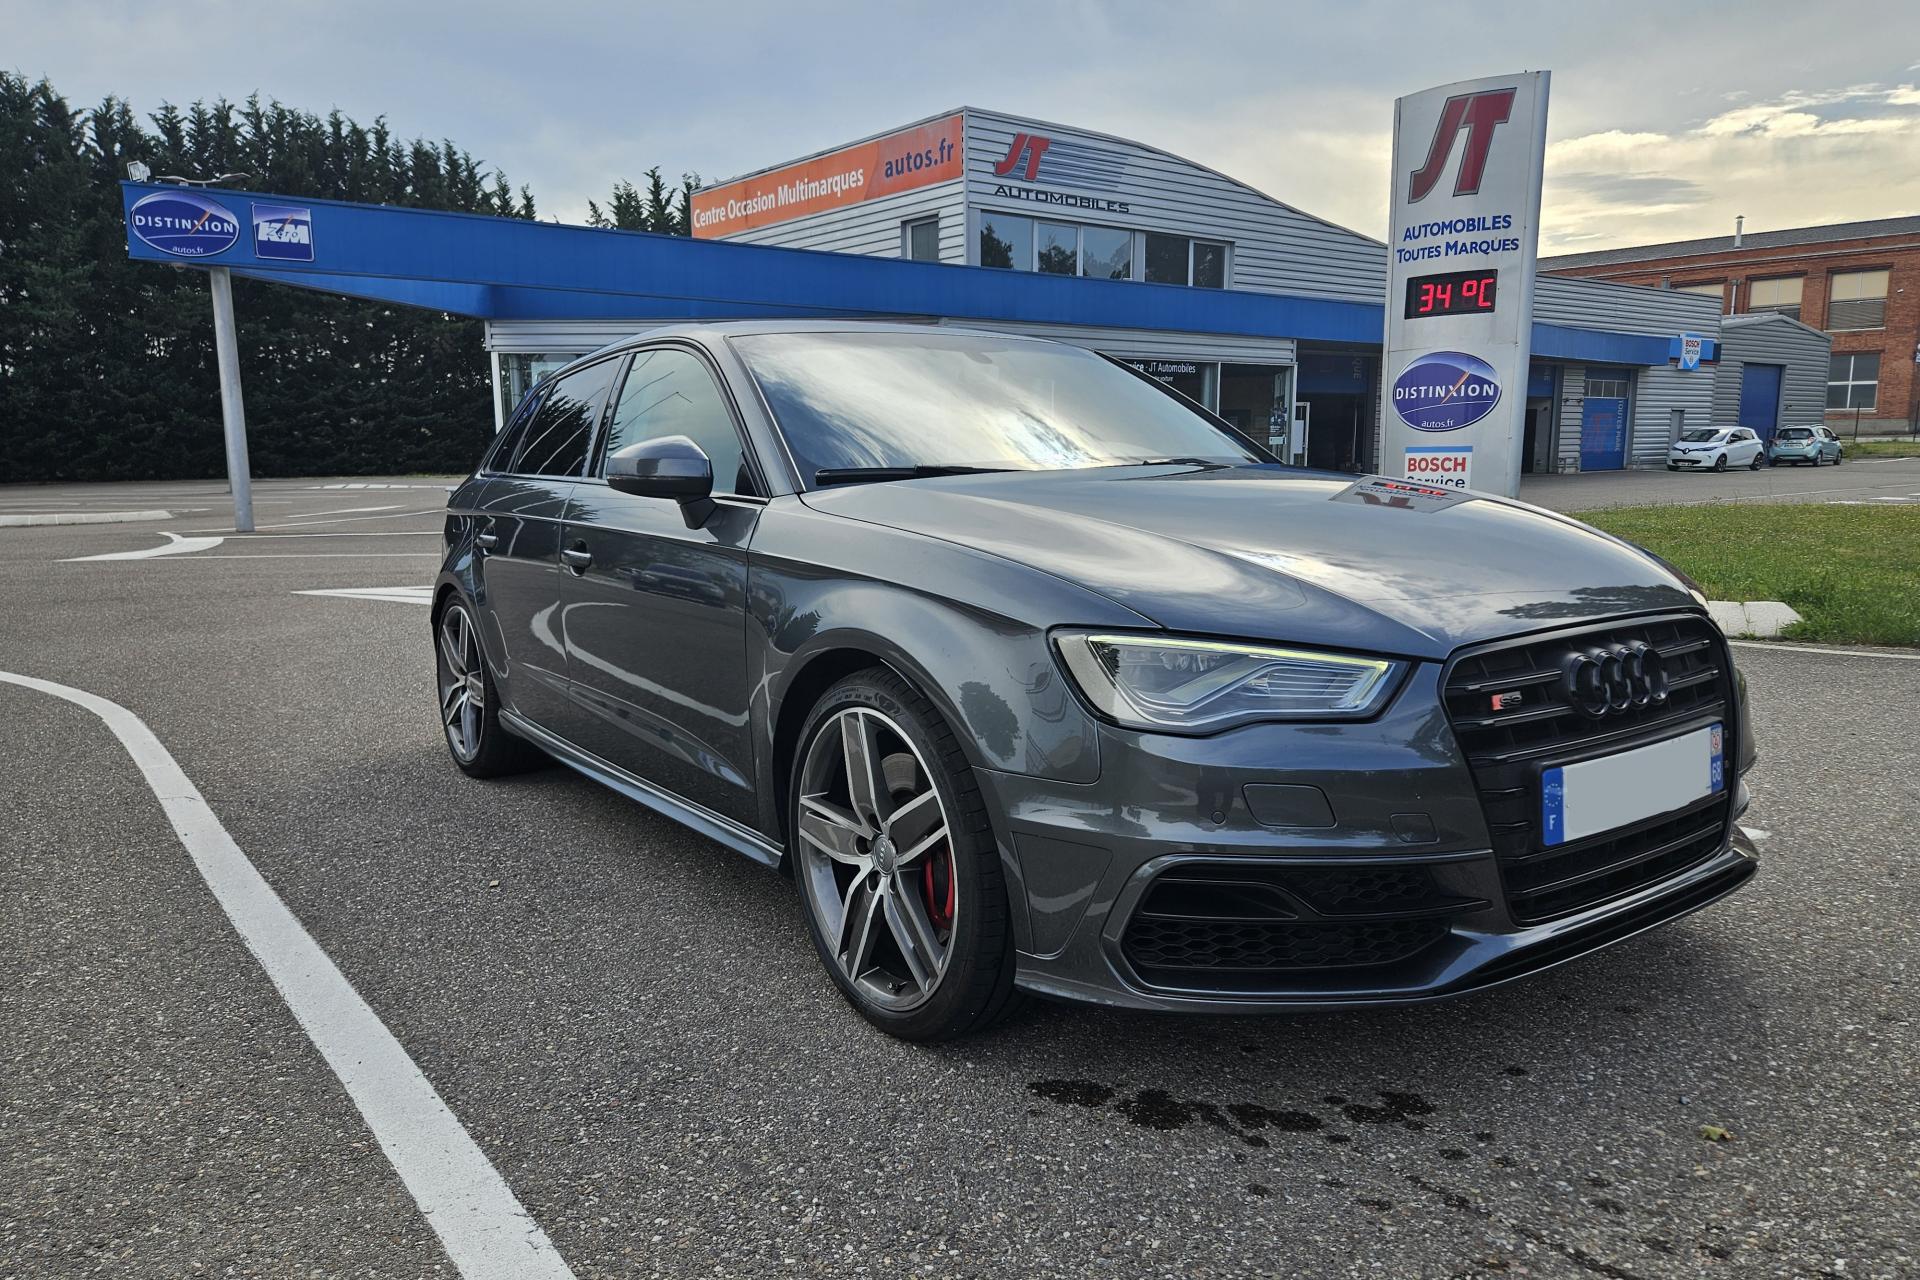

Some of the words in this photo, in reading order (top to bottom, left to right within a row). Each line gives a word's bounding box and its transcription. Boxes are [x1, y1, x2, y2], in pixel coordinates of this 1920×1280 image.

[1408, 87, 1517, 204] JT
[884, 138, 954, 178] autos.fr
[994, 132, 1050, 182] JT
[694, 206, 726, 228] Centre
[727, 192, 775, 220] Occasion
[778, 167, 864, 206] Multimarques
[994, 185, 1130, 214] AUTOMOBILES
[135, 214, 234, 233] DISTINXION
[1403, 214, 1512, 242] AUTOMOBILES
[172, 246, 204, 254] autos.fr
[1397, 246, 1441, 264] TOUTES
[1445, 238, 1519, 257] MARQUES
[1419, 283, 1452, 312] 34
[1685, 339, 1700, 348] BOSCH
[1149, 362, 1157, 372] JT
[1158, 362, 1196, 374] Automobiles
[1396, 383, 1495, 401] DISTINXION
[1421, 419, 1455, 429] autos.fr
[1408, 456, 1467, 473] BOSCH
[1549, 814, 1557, 830] F
